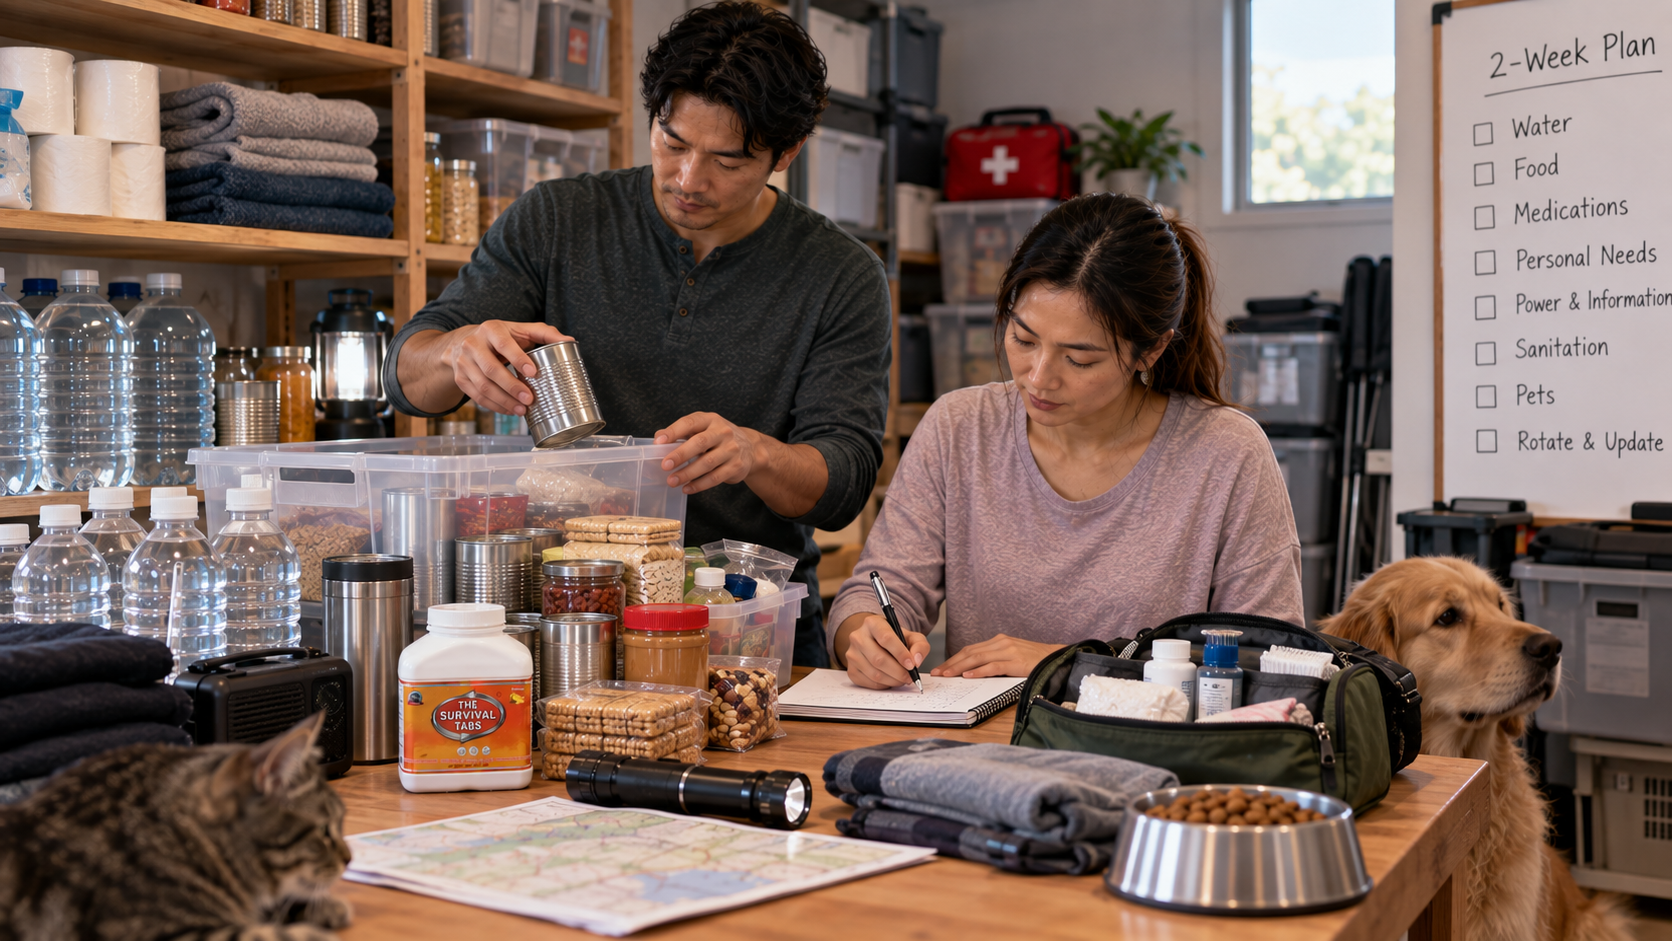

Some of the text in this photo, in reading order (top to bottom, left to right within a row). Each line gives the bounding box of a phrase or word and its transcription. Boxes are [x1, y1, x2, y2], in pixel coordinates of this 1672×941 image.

[1490, 31, 1655, 79] 2-Week Plan
[1512, 114, 1572, 139] Water
[1515, 153, 1558, 180] Food
[1515, 197, 1628, 224] Medications
[1517, 240, 1657, 271] Personal Needs
[1516, 287, 1672, 314] Power & Information
[1515, 336, 1608, 359] Sanitation
[1517, 384, 1555, 406] Pets
[1518, 430, 1664, 459] Rotate & Update
[440, 710, 496, 720] SURVIVAL
[458, 700, 477, 709] THE
[454, 721, 481, 730] TABS
